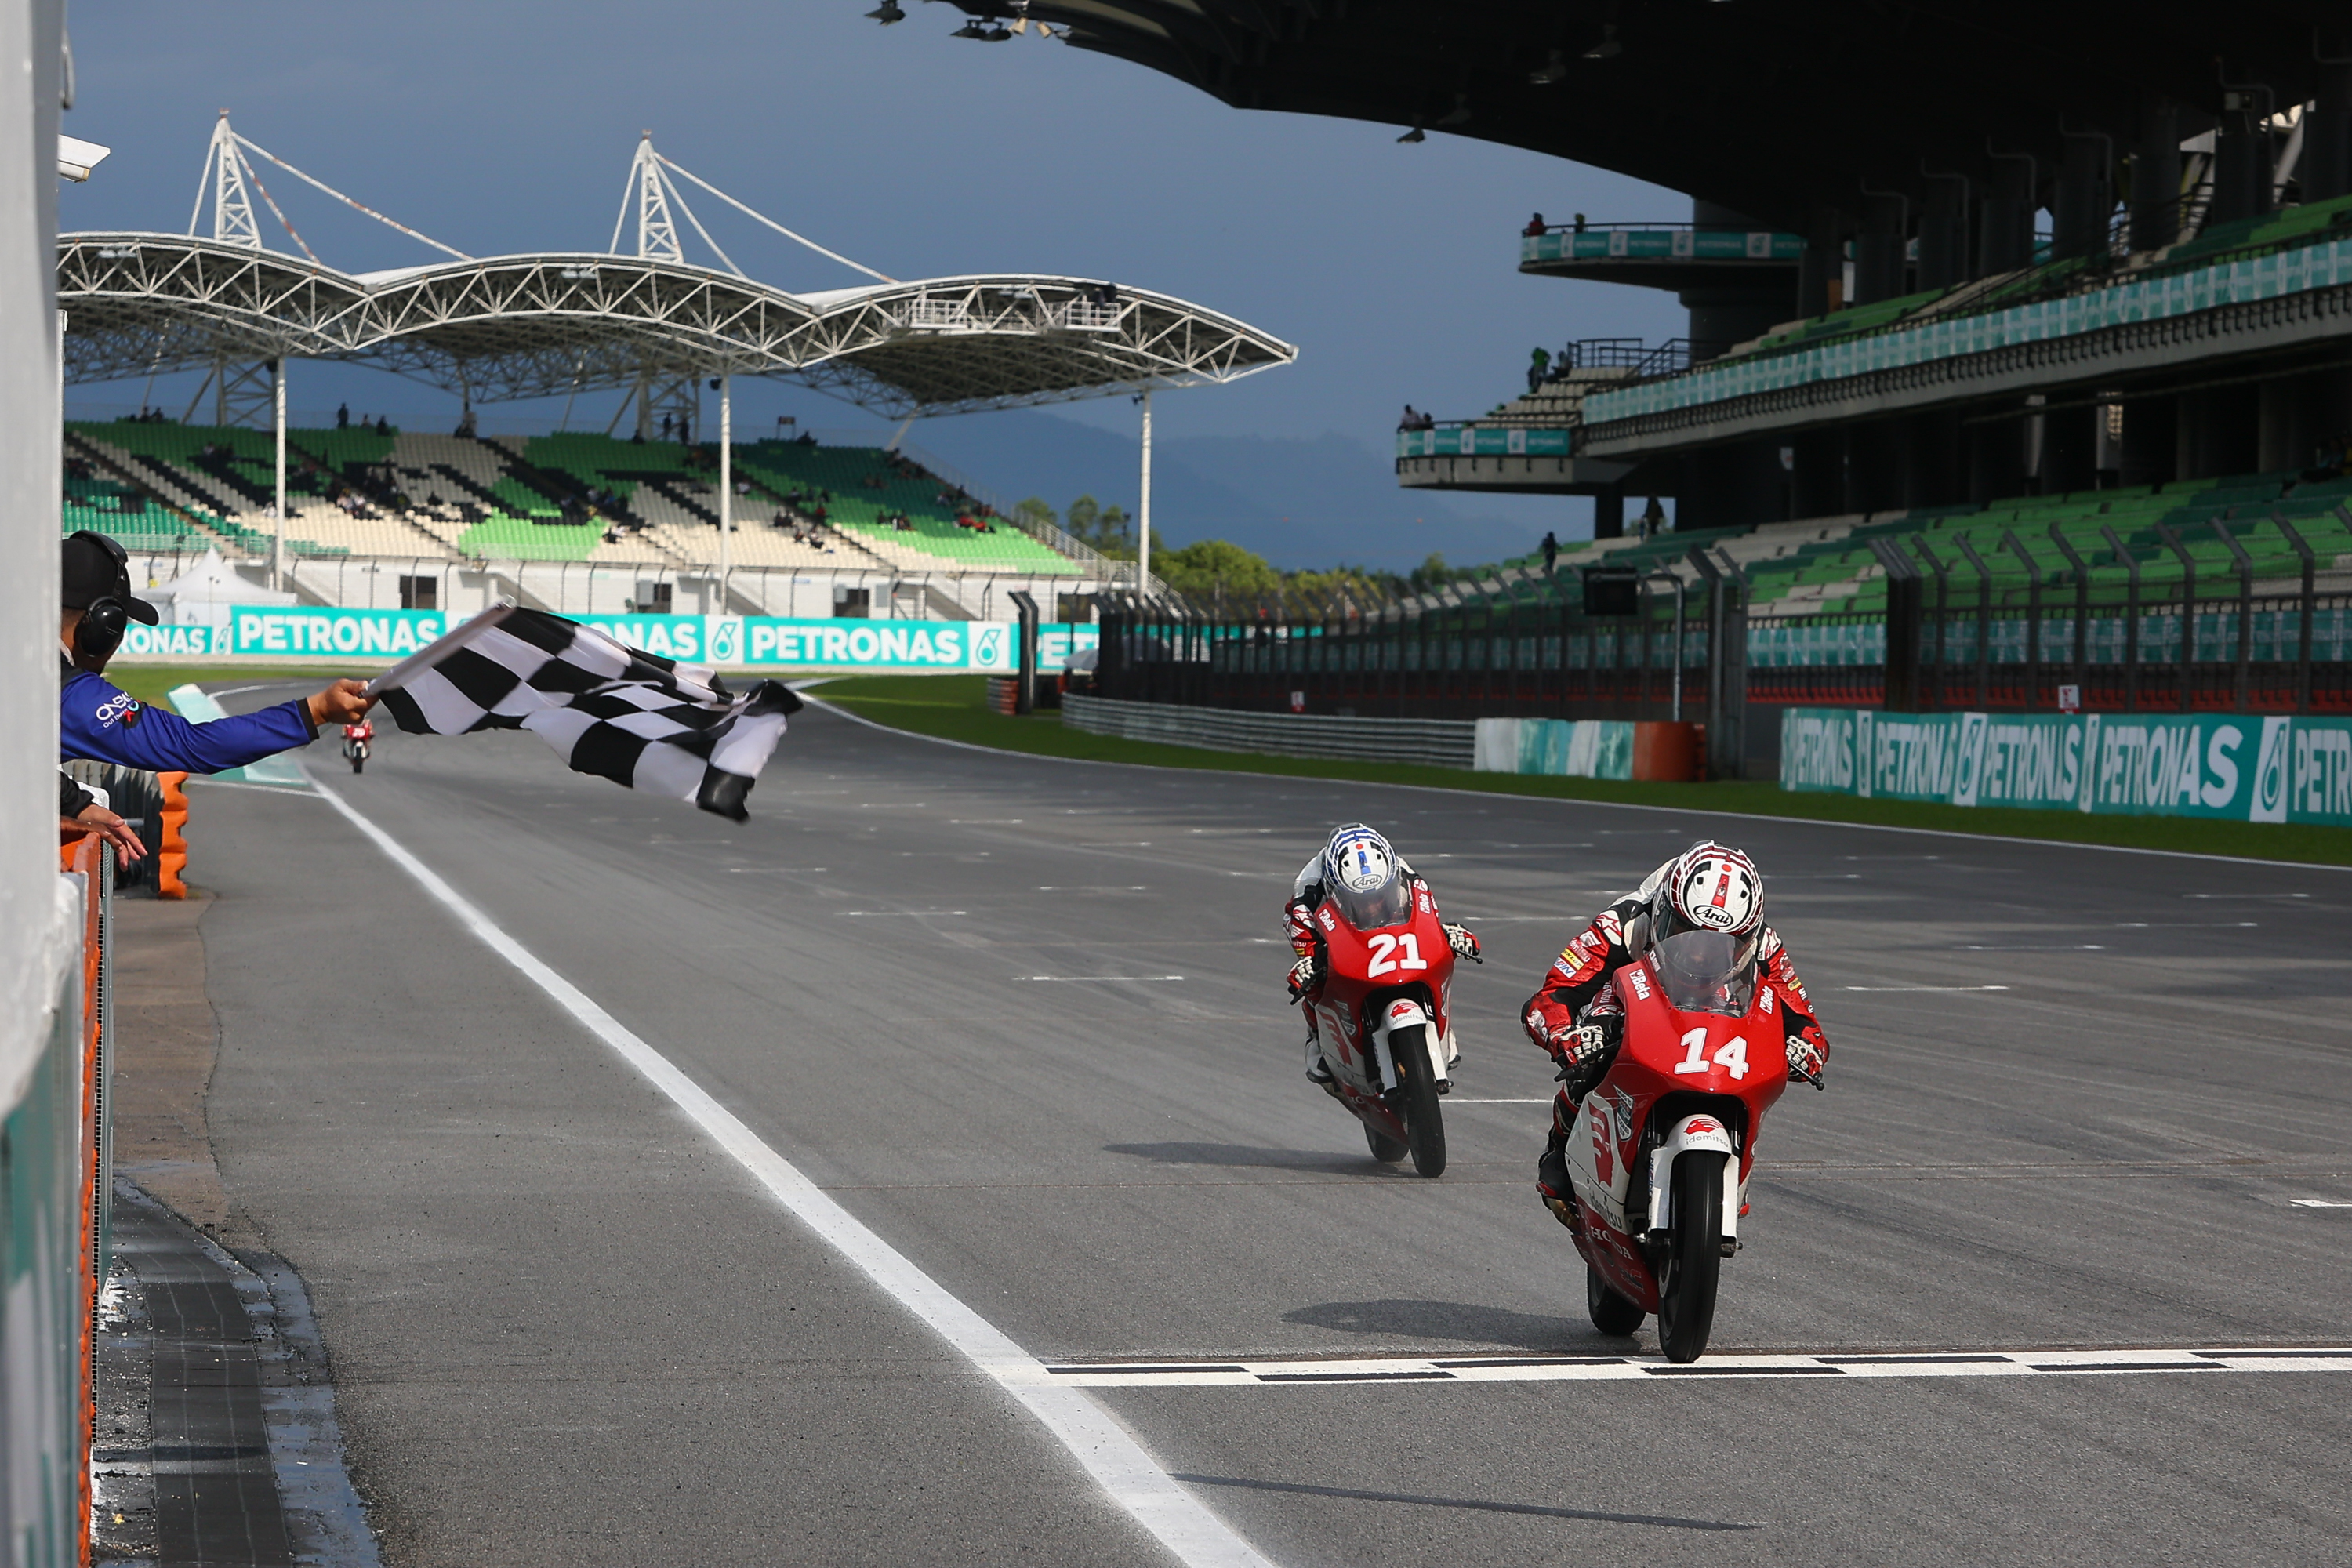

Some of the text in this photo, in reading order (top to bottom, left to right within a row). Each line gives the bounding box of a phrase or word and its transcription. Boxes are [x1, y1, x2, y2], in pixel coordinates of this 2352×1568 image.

[239, 614, 441, 652] PETRONAS
[751, 625, 961, 664] PETRONAS
[2099, 724, 2244, 808] PETRONAS
[2294, 729, 2352, 815] PETR
[1355, 876, 1379, 887] Arai
[1323, 913, 1336, 932] Beta
[1696, 908, 1730, 924] Arai
[1367, 933, 1428, 978] 21
[1632, 975, 1650, 1000] Beta
[1760, 985, 1773, 1008] Beta
[1392, 1014, 1424, 1025] idemitsu
[1674, 1027, 1749, 1080] 14
[1686, 1134, 1729, 1148] idemitsu
